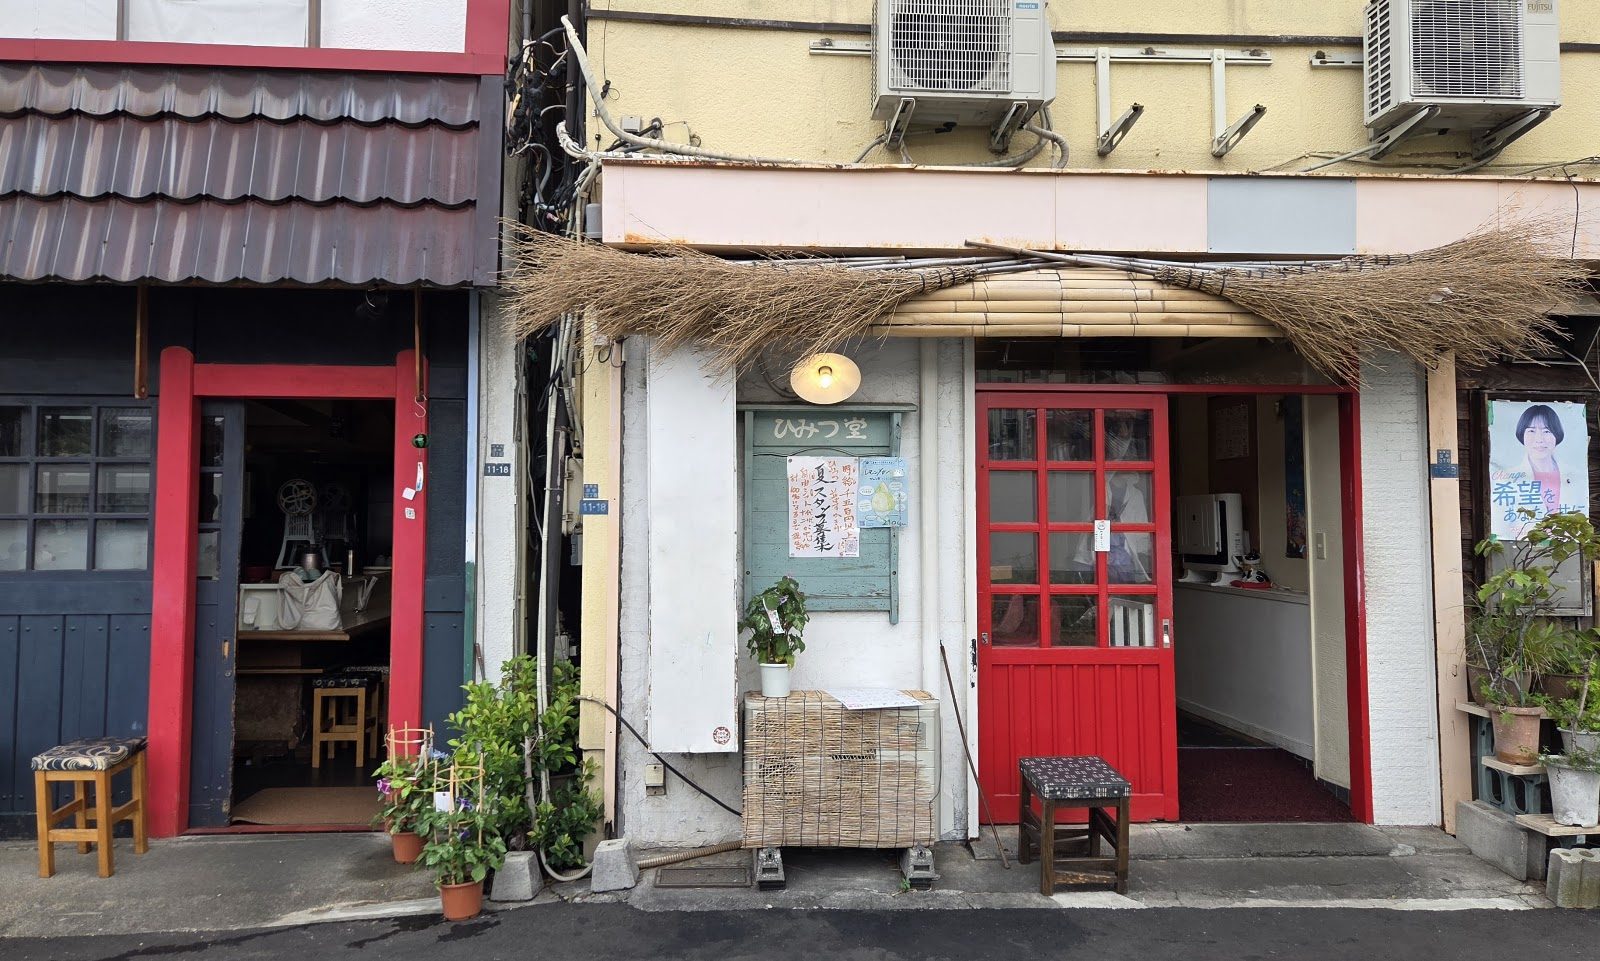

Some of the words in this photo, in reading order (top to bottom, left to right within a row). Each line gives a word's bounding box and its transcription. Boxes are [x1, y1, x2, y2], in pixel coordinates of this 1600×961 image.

[1527, 3, 1553, 12] FUJITSU
[774, 417, 868, 440] ひみつ堂
[487, 465, 509, 474] 11-18
[1492, 470, 1526, 484] Change
[1492, 481, 1556, 506] 希望を
[582, 502, 606, 512] 11-18
